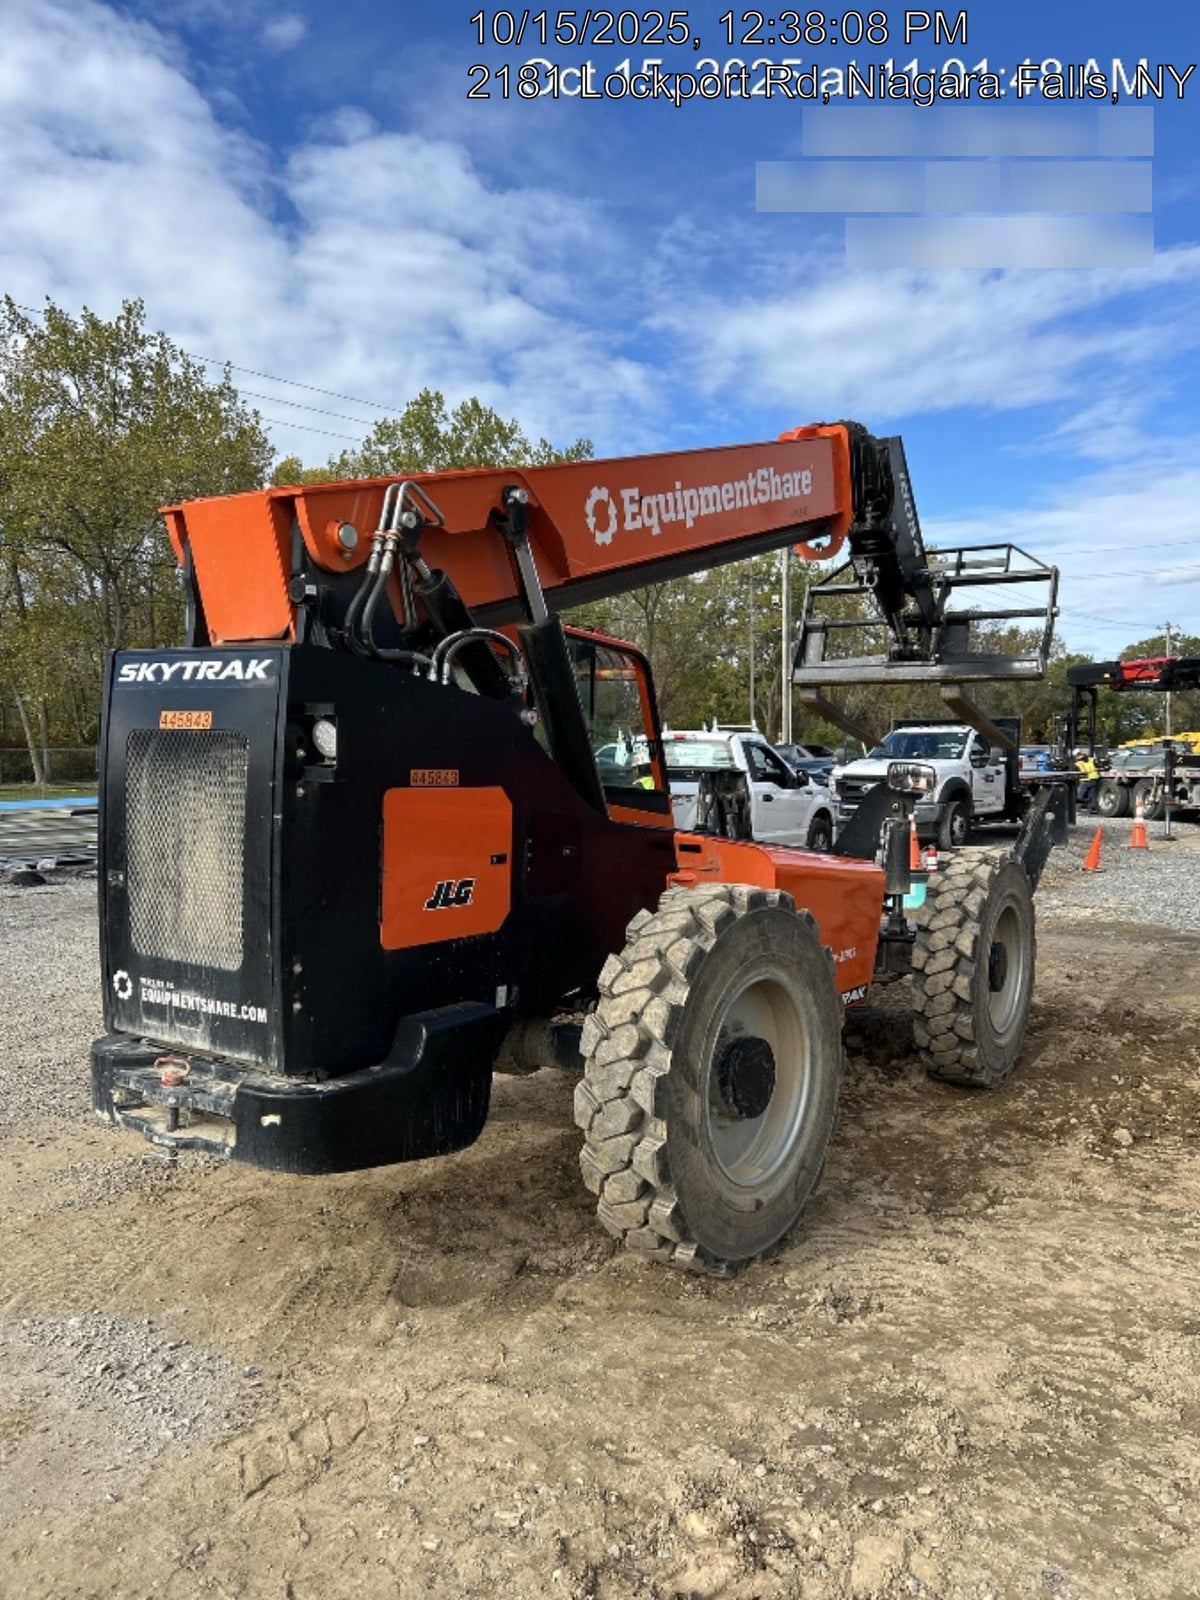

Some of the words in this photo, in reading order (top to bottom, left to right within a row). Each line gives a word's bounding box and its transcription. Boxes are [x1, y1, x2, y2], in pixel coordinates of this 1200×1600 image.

[620, 467, 812, 536] EquipmentShare
[118, 659, 274, 684] SKYTRAK
[161, 712, 211, 728] 445843
[423, 877, 476, 911] JLG
[141, 988, 268, 1023] EQUIPMENTSHARE.COM
